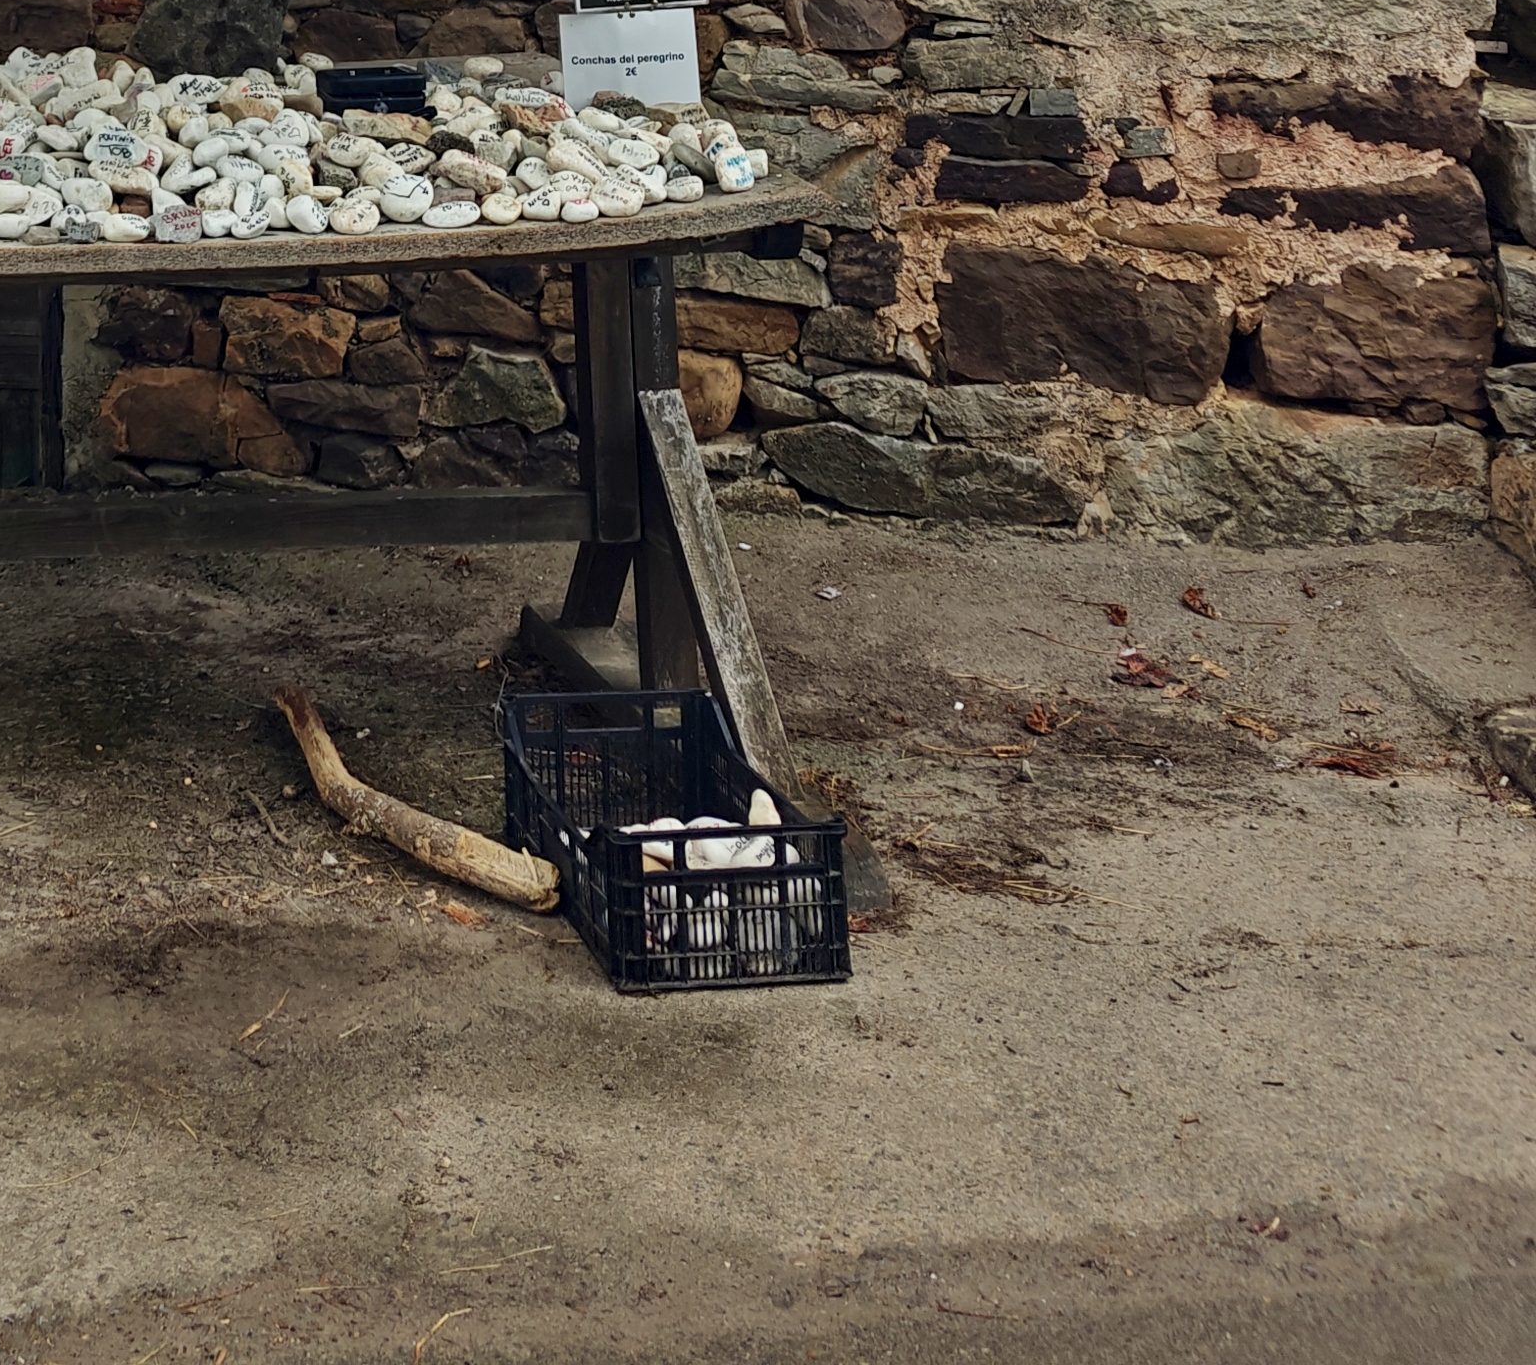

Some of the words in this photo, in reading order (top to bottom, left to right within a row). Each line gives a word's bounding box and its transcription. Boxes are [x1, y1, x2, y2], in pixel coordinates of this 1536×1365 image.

[571, 56, 616, 65] Conchas
[619, 54, 635, 64] del
[637, 52, 685, 65] peregrino
[625, 67, 638, 77] 2€
